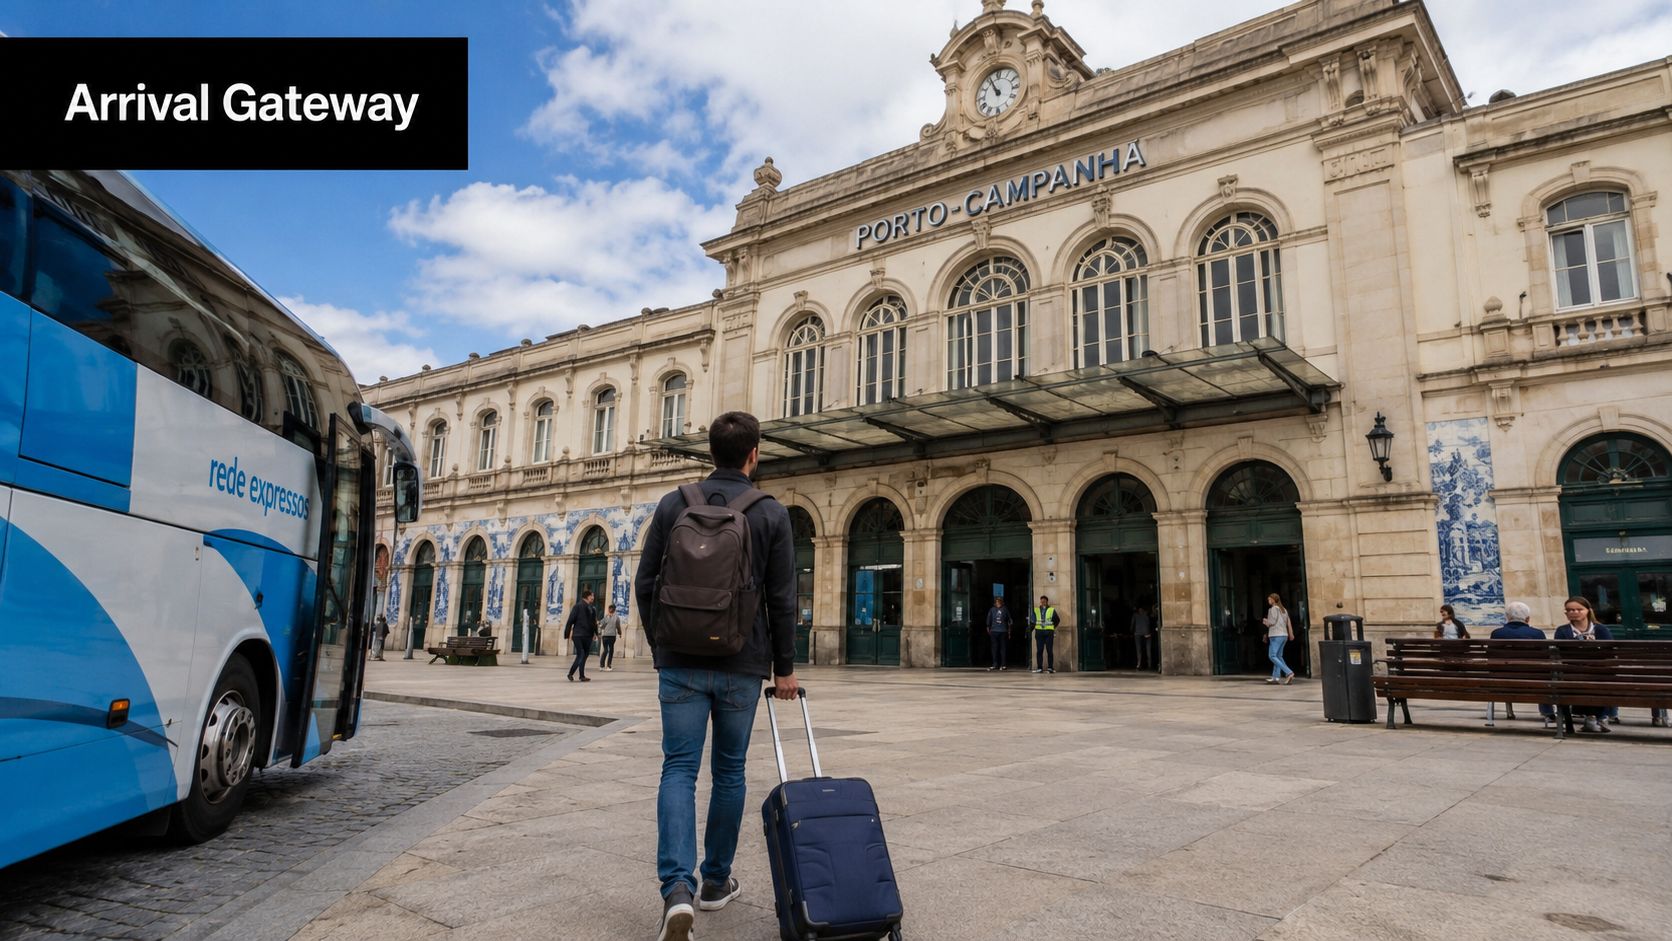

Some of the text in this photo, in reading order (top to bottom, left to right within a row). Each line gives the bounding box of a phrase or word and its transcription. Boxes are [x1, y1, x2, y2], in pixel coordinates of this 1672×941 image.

[856, 138, 1147, 250] PORTO-CAMPANHÃ
[208, 456, 310, 520] rede expressos
